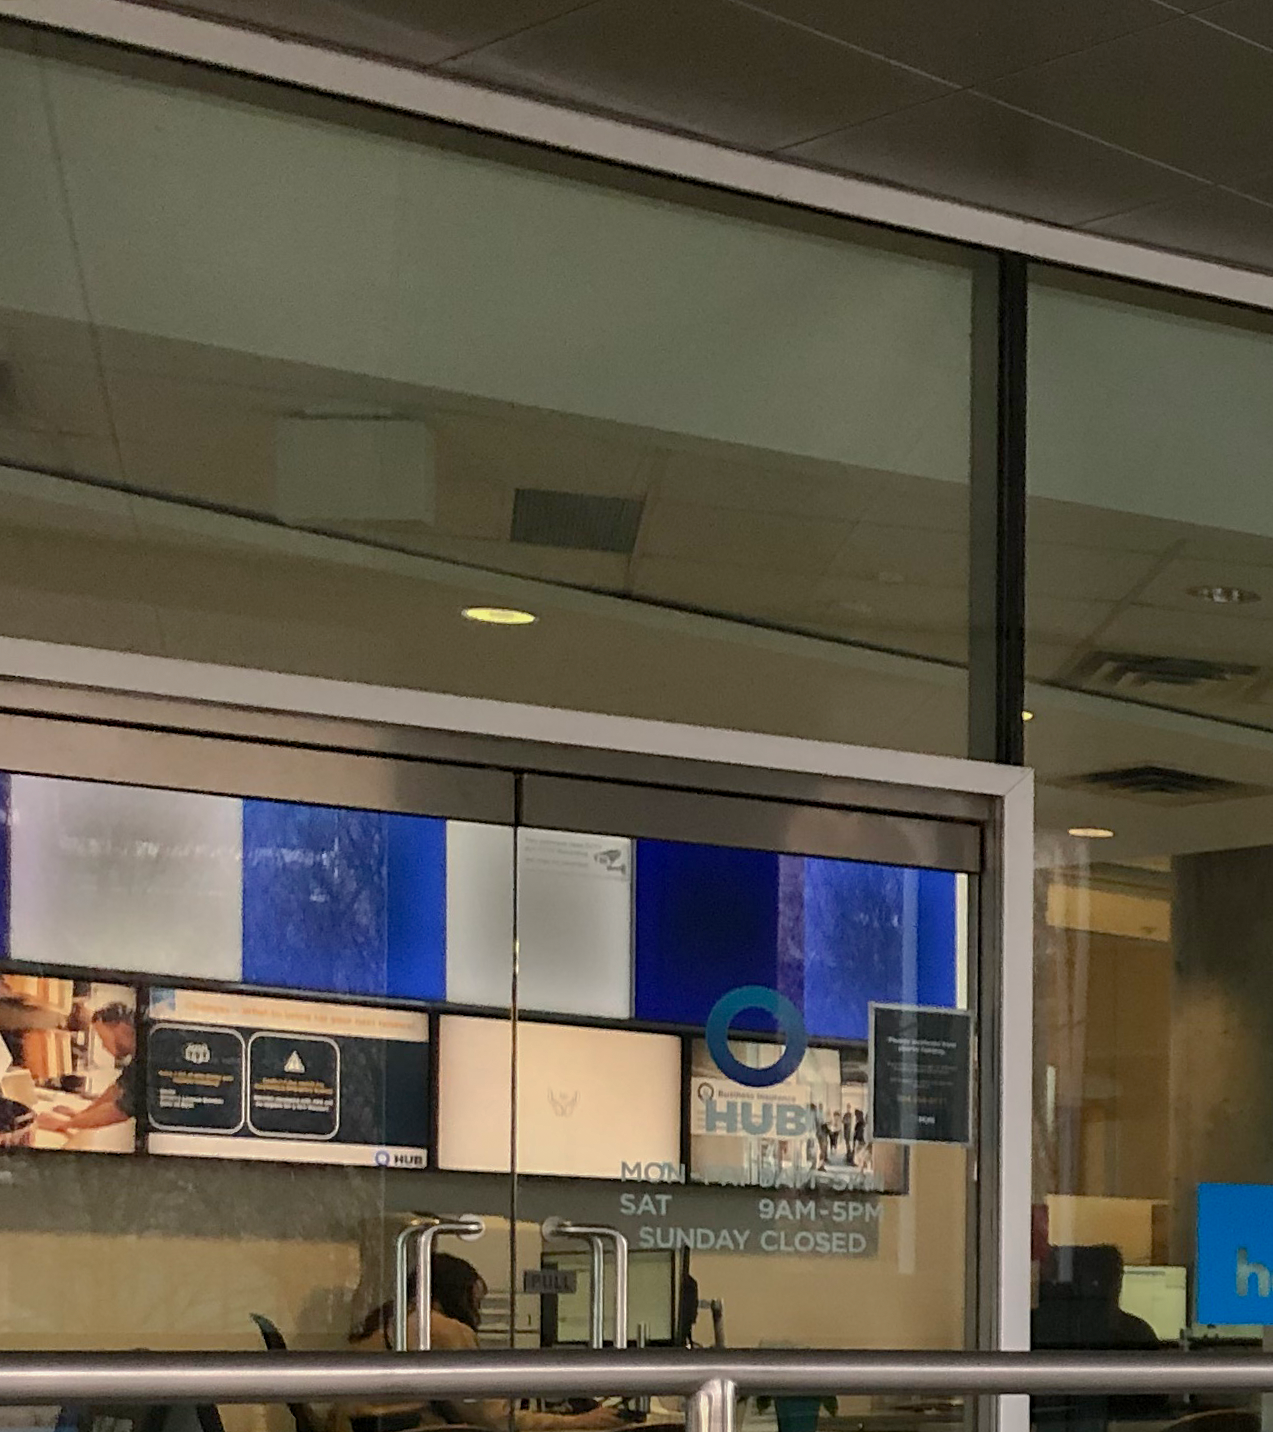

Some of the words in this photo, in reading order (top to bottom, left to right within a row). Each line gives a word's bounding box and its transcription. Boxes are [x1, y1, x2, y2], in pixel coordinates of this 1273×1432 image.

[706, 1100, 807, 1136] HUB
[621, 1161, 686, 1184] MON
[619, 1193, 673, 1216] SAT
[758, 1198, 885, 1223] 9AM-5PM
[639, 1226, 751, 1251] SUNDAY
[760, 1230, 867, 1254] CLOSED
